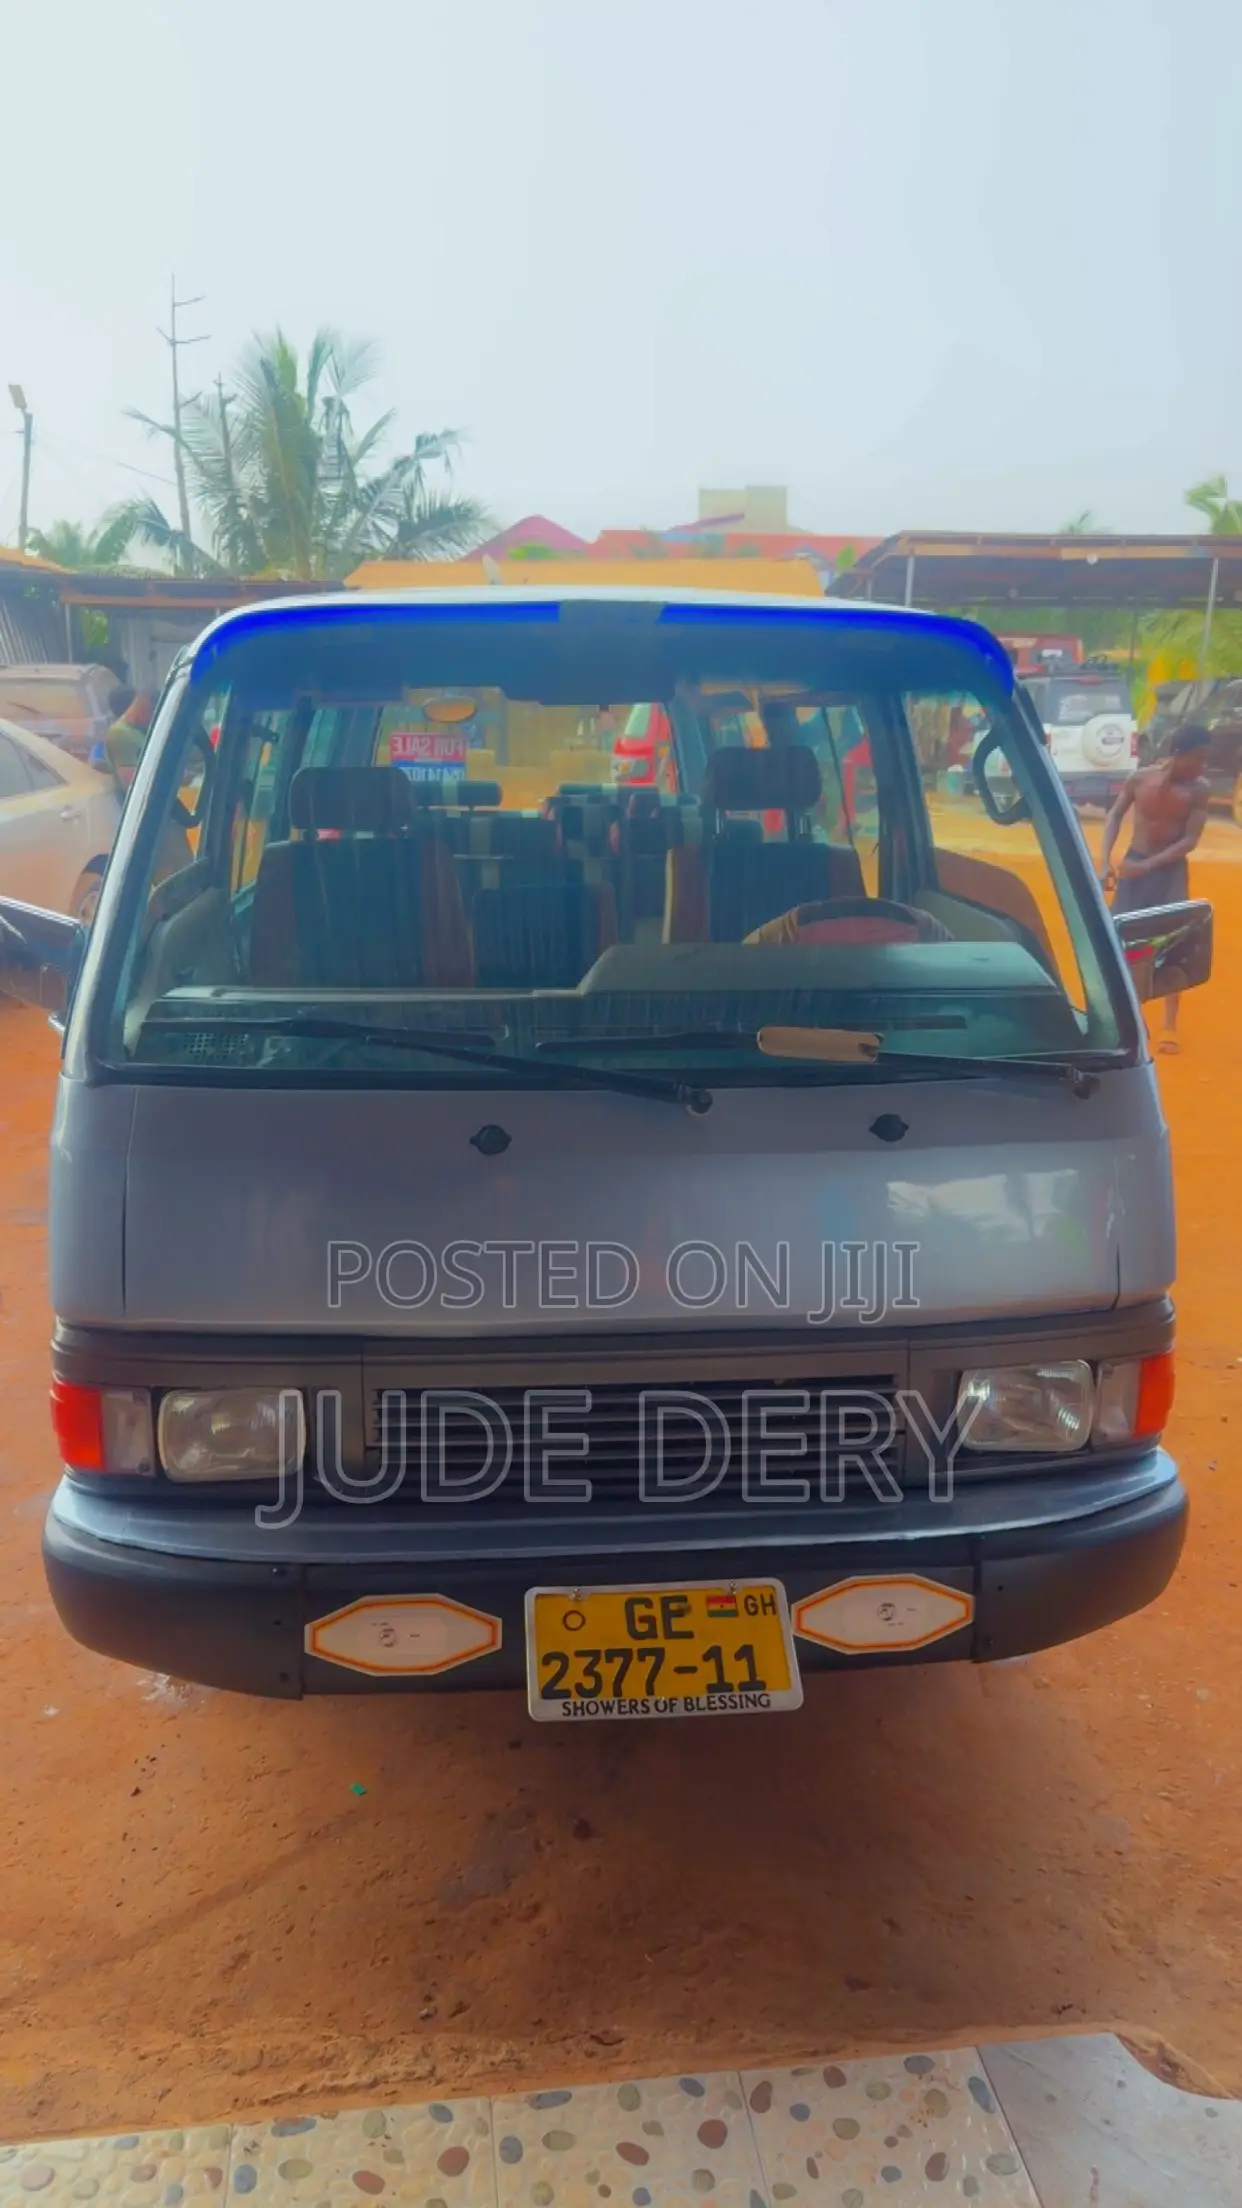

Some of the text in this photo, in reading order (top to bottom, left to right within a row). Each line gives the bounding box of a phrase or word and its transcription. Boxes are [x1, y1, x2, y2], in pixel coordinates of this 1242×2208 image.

[624, 1595, 694, 1641] GE
[743, 1593, 778, 1617] GH
[541, 1645, 767, 1700] 2377-11
[562, 1694, 771, 1717] SHOWERS OF BLESSING
